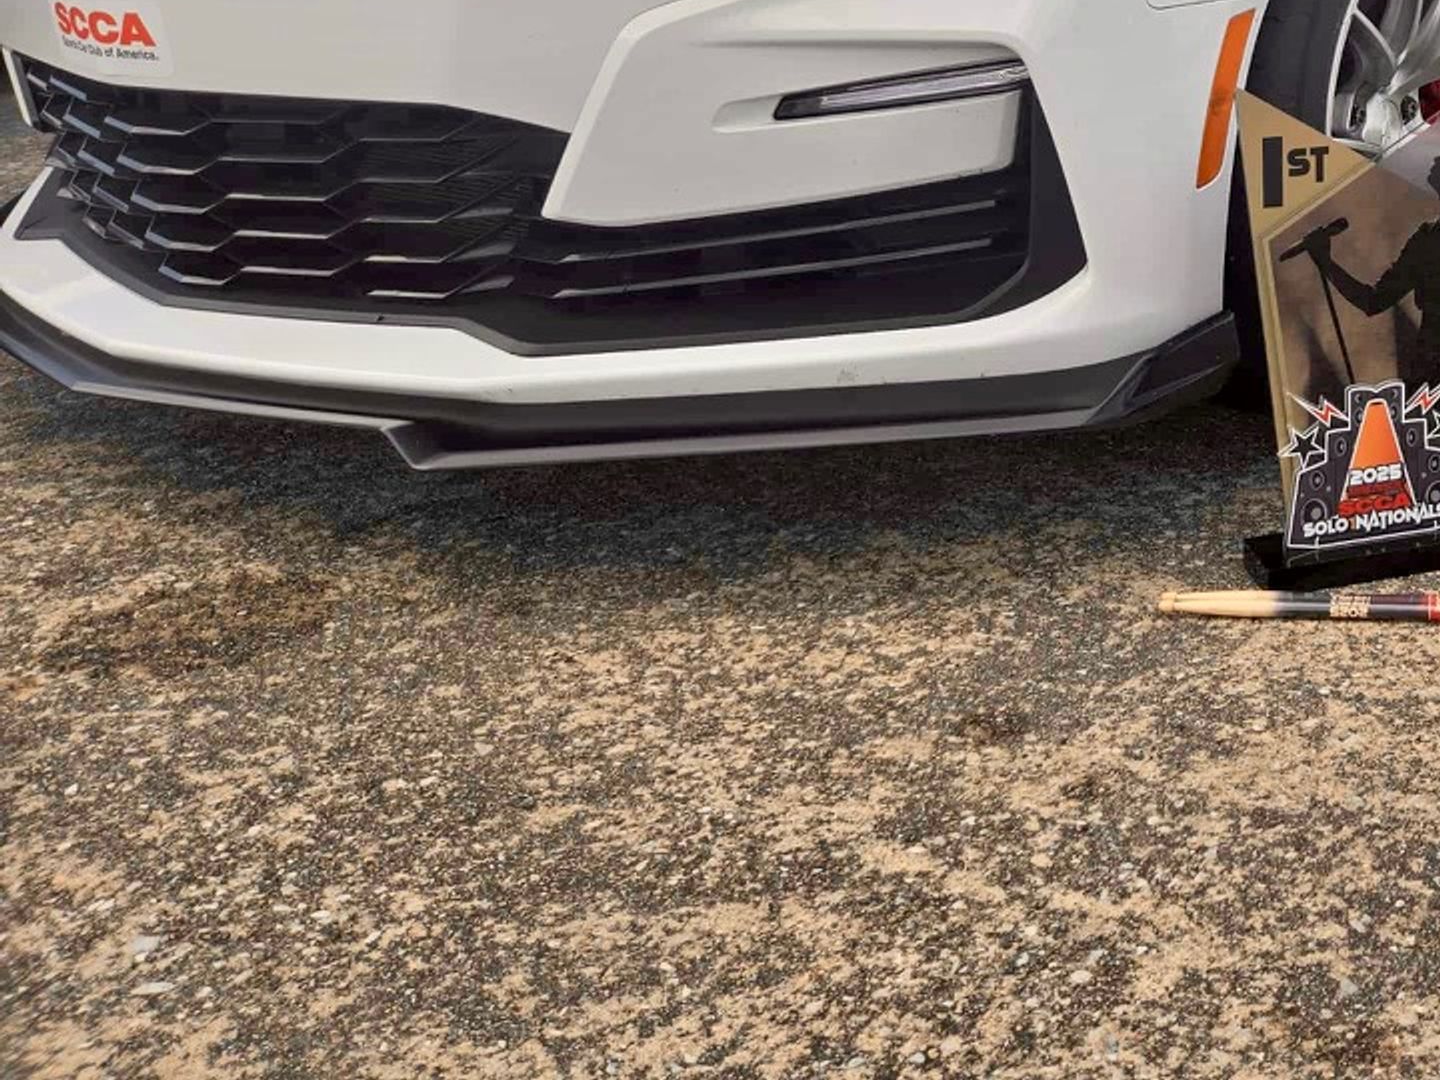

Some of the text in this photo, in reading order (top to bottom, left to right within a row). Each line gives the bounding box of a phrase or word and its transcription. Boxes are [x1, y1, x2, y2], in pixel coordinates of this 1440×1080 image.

[54, 1, 156, 47] SCCA
[1262, 135, 1329, 209] 1ST
[1350, 463, 1402, 486] 2025
[1338, 492, 1411, 517] SCCA
[1303, 513, 1349, 538] SOLO
